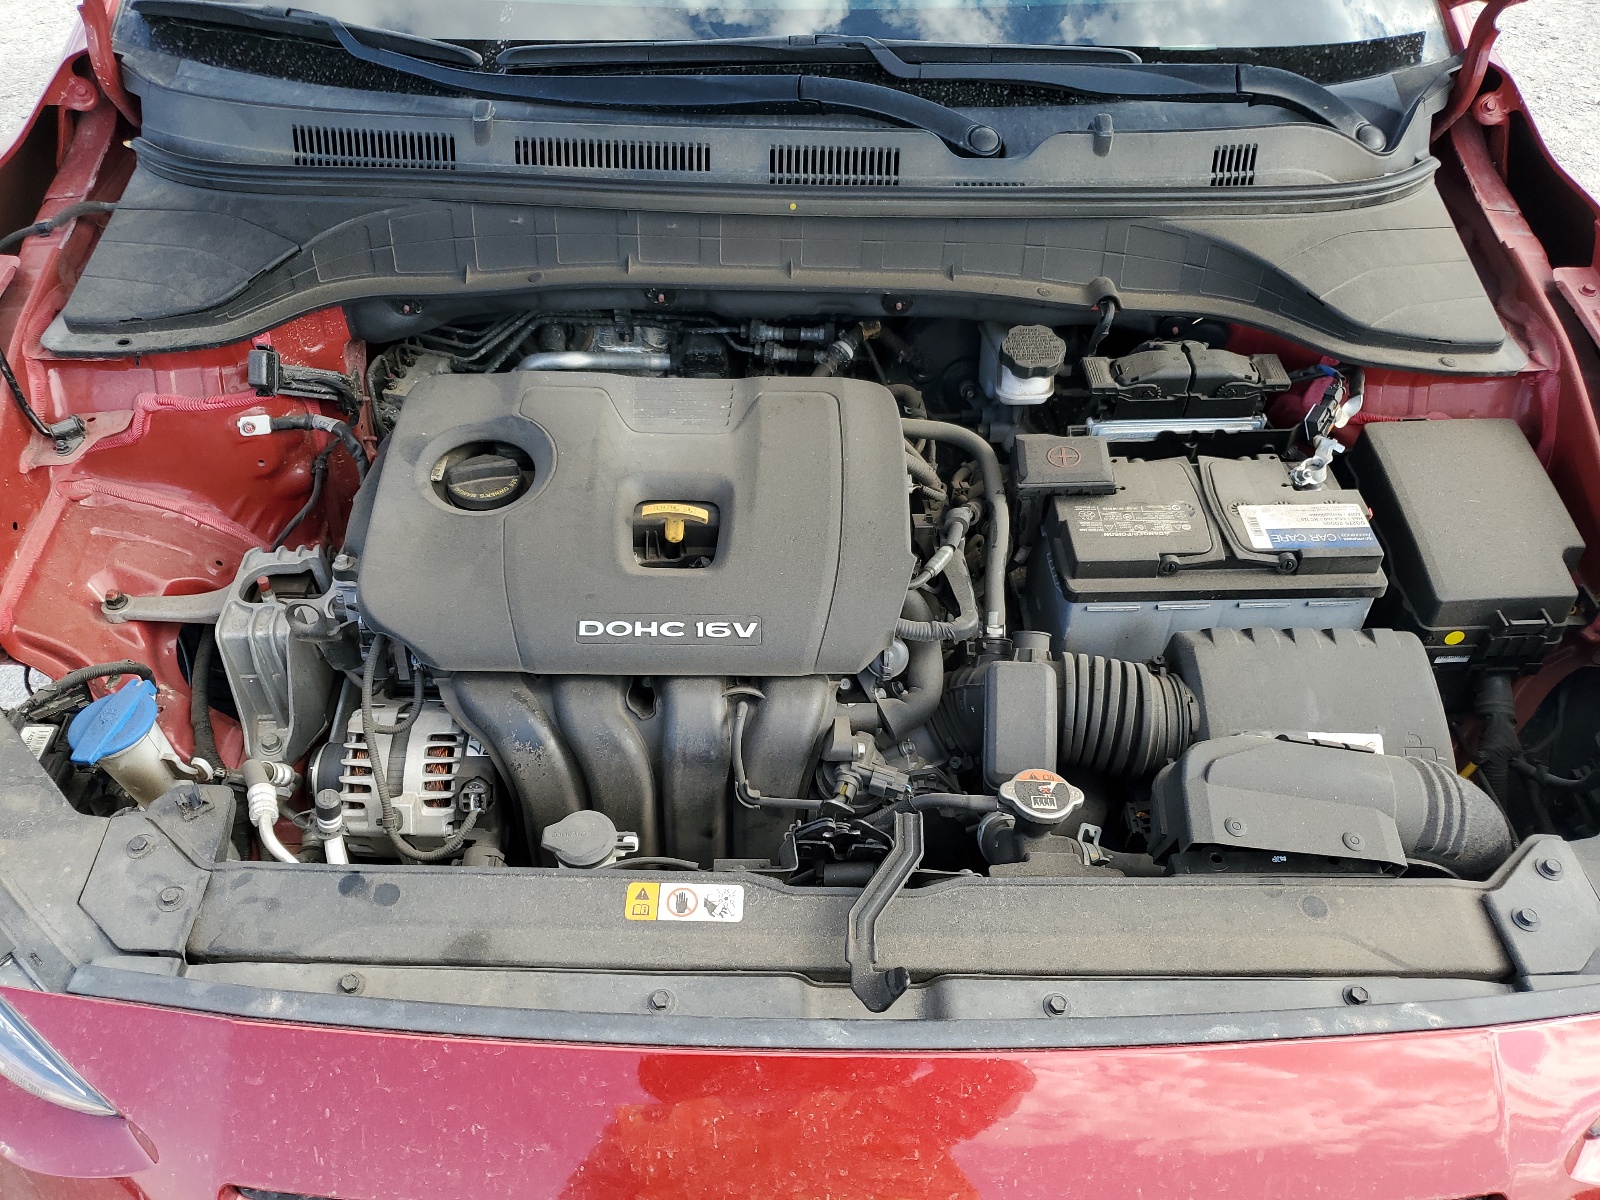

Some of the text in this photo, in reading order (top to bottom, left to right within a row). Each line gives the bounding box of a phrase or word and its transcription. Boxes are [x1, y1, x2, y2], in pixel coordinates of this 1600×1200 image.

[479, 487, 509, 499] OWNER'S
[1270, 533, 1337, 543] CAR CARE
[578, 620, 758, 638] DOHC 16V
